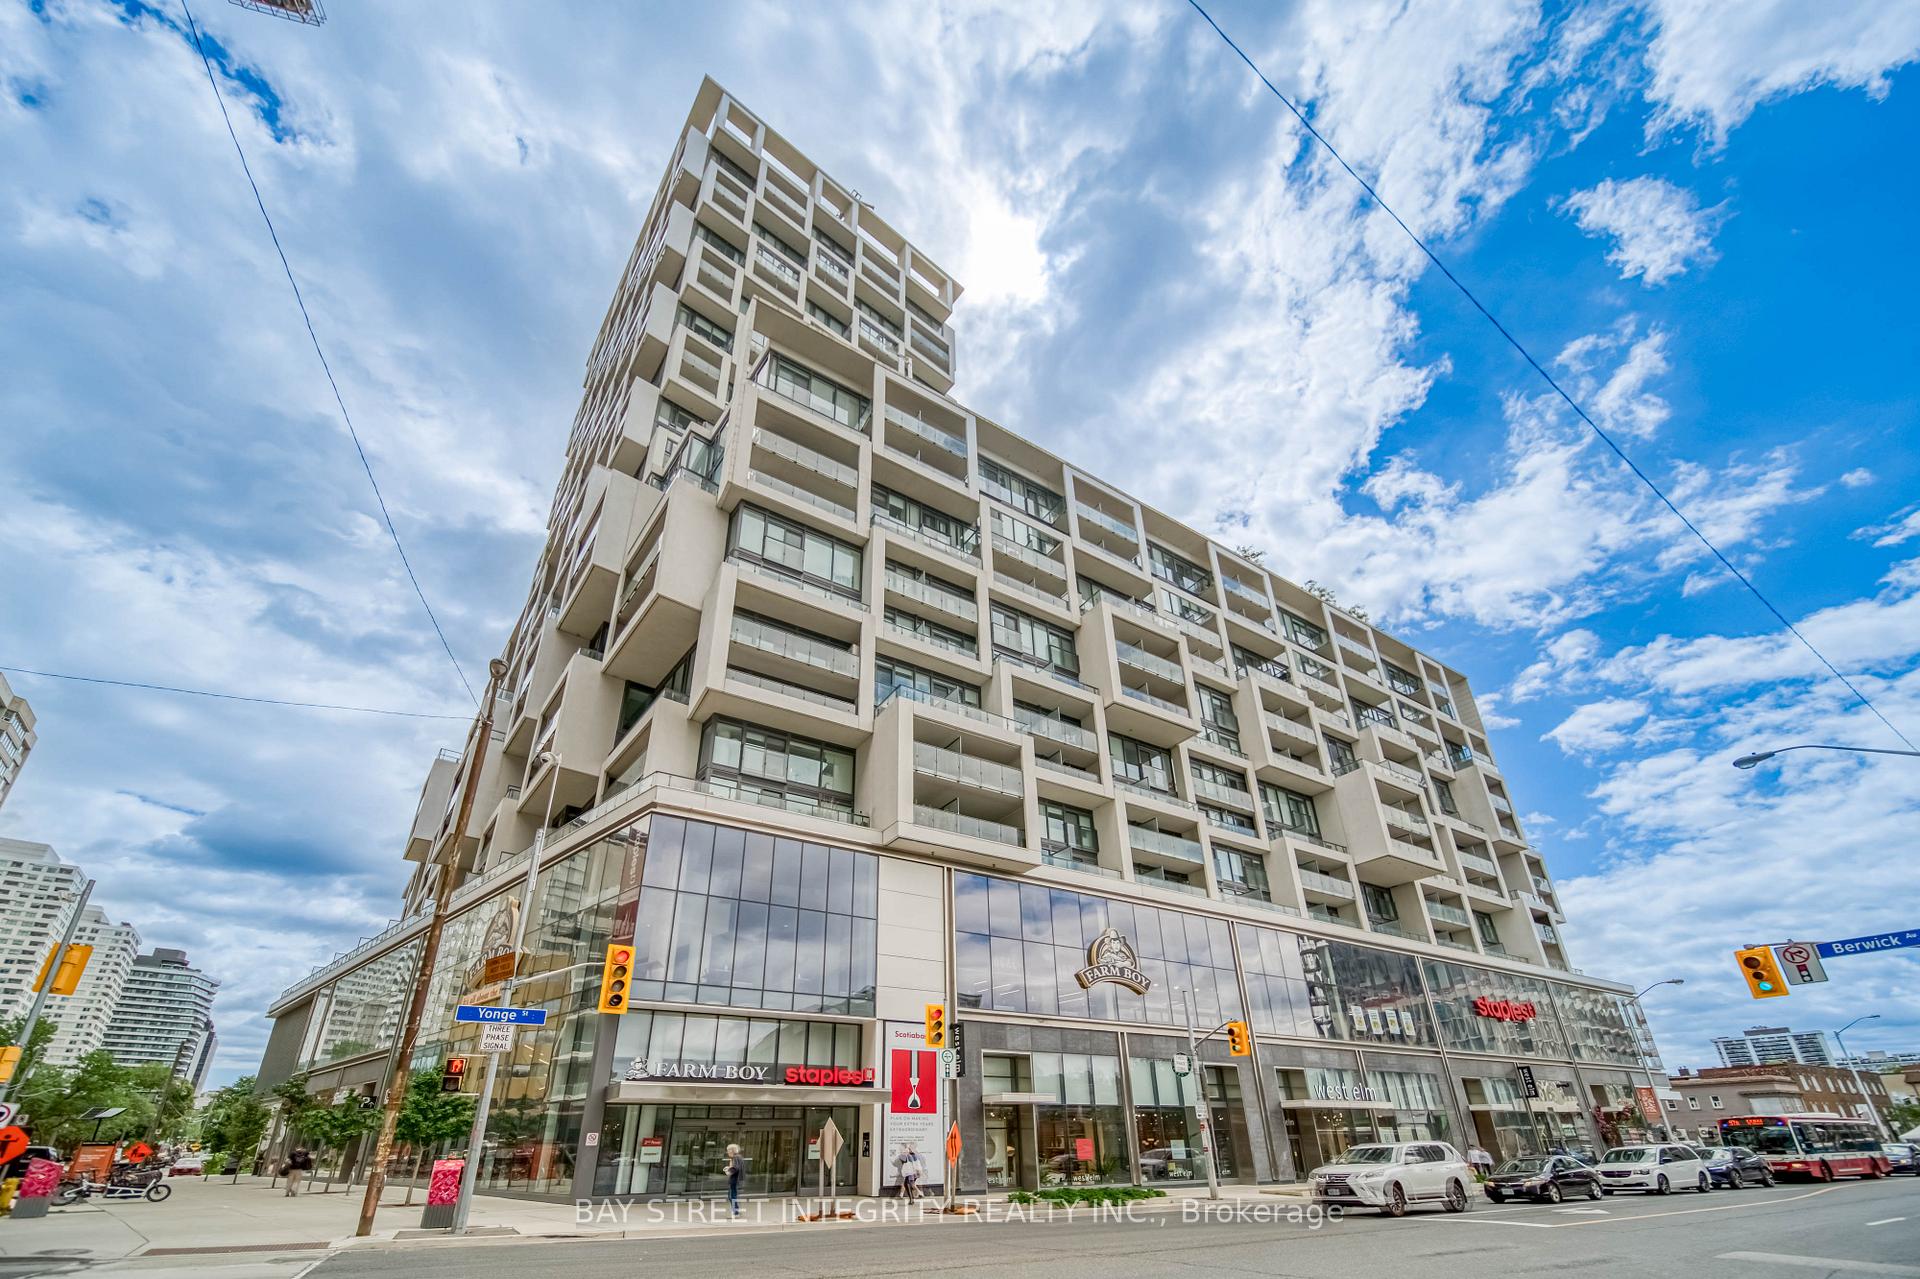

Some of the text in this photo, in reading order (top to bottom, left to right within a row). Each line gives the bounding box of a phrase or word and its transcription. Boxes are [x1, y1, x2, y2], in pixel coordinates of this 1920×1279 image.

[1832, 935, 1902, 954] Berwick
[1085, 966, 1150, 987] FARM BOY
[478, 1008, 517, 1022] Yonge
[486, 1034, 510, 1042] PHASE
[895, 1030, 926, 1039] Scotiaba
[483, 1042, 509, 1050] SIGNAL
[654, 1062, 769, 1081] FARM BOY
[785, 1064, 863, 1087] staples
[1314, 1082, 1377, 1102] west elm
